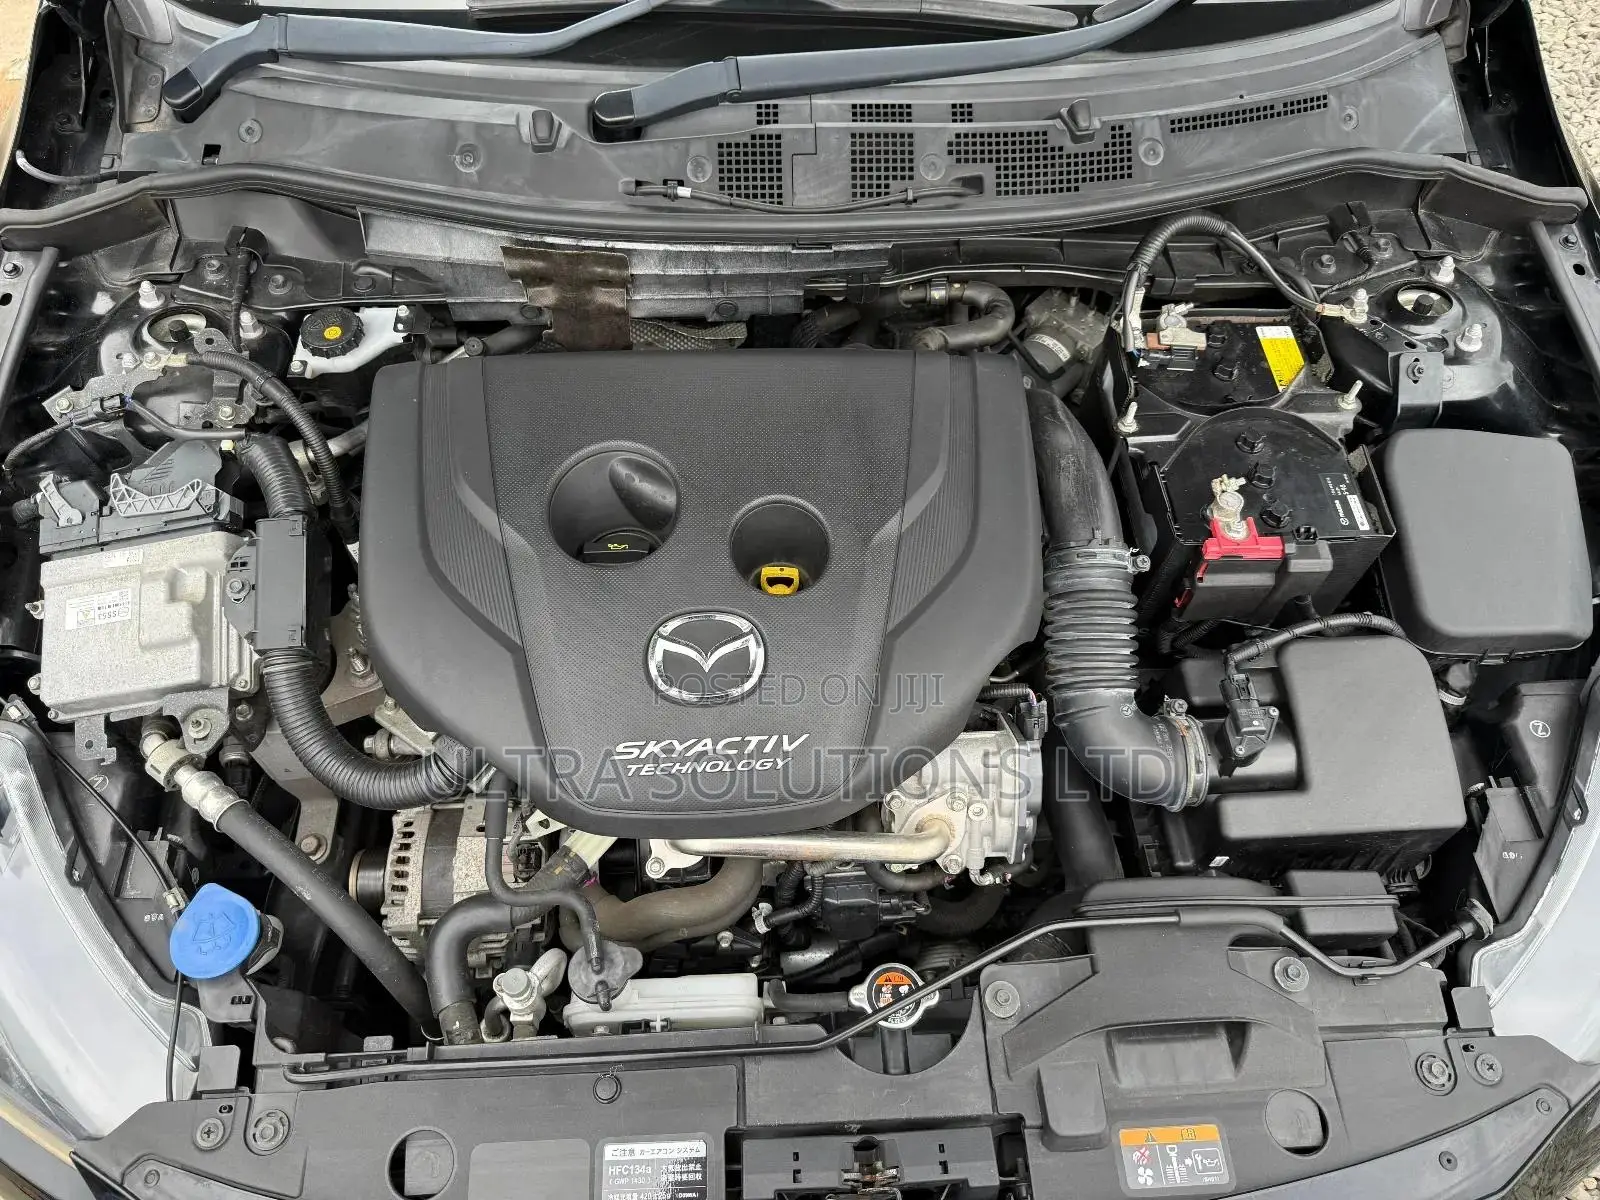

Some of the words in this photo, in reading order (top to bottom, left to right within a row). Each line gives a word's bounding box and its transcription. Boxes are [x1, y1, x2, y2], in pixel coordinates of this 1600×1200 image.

[610, 733, 810, 761] SKYACTIV
[625, 757, 793, 776] TECHNOLOGY
[608, 1164, 652, 1176] HFC134a
